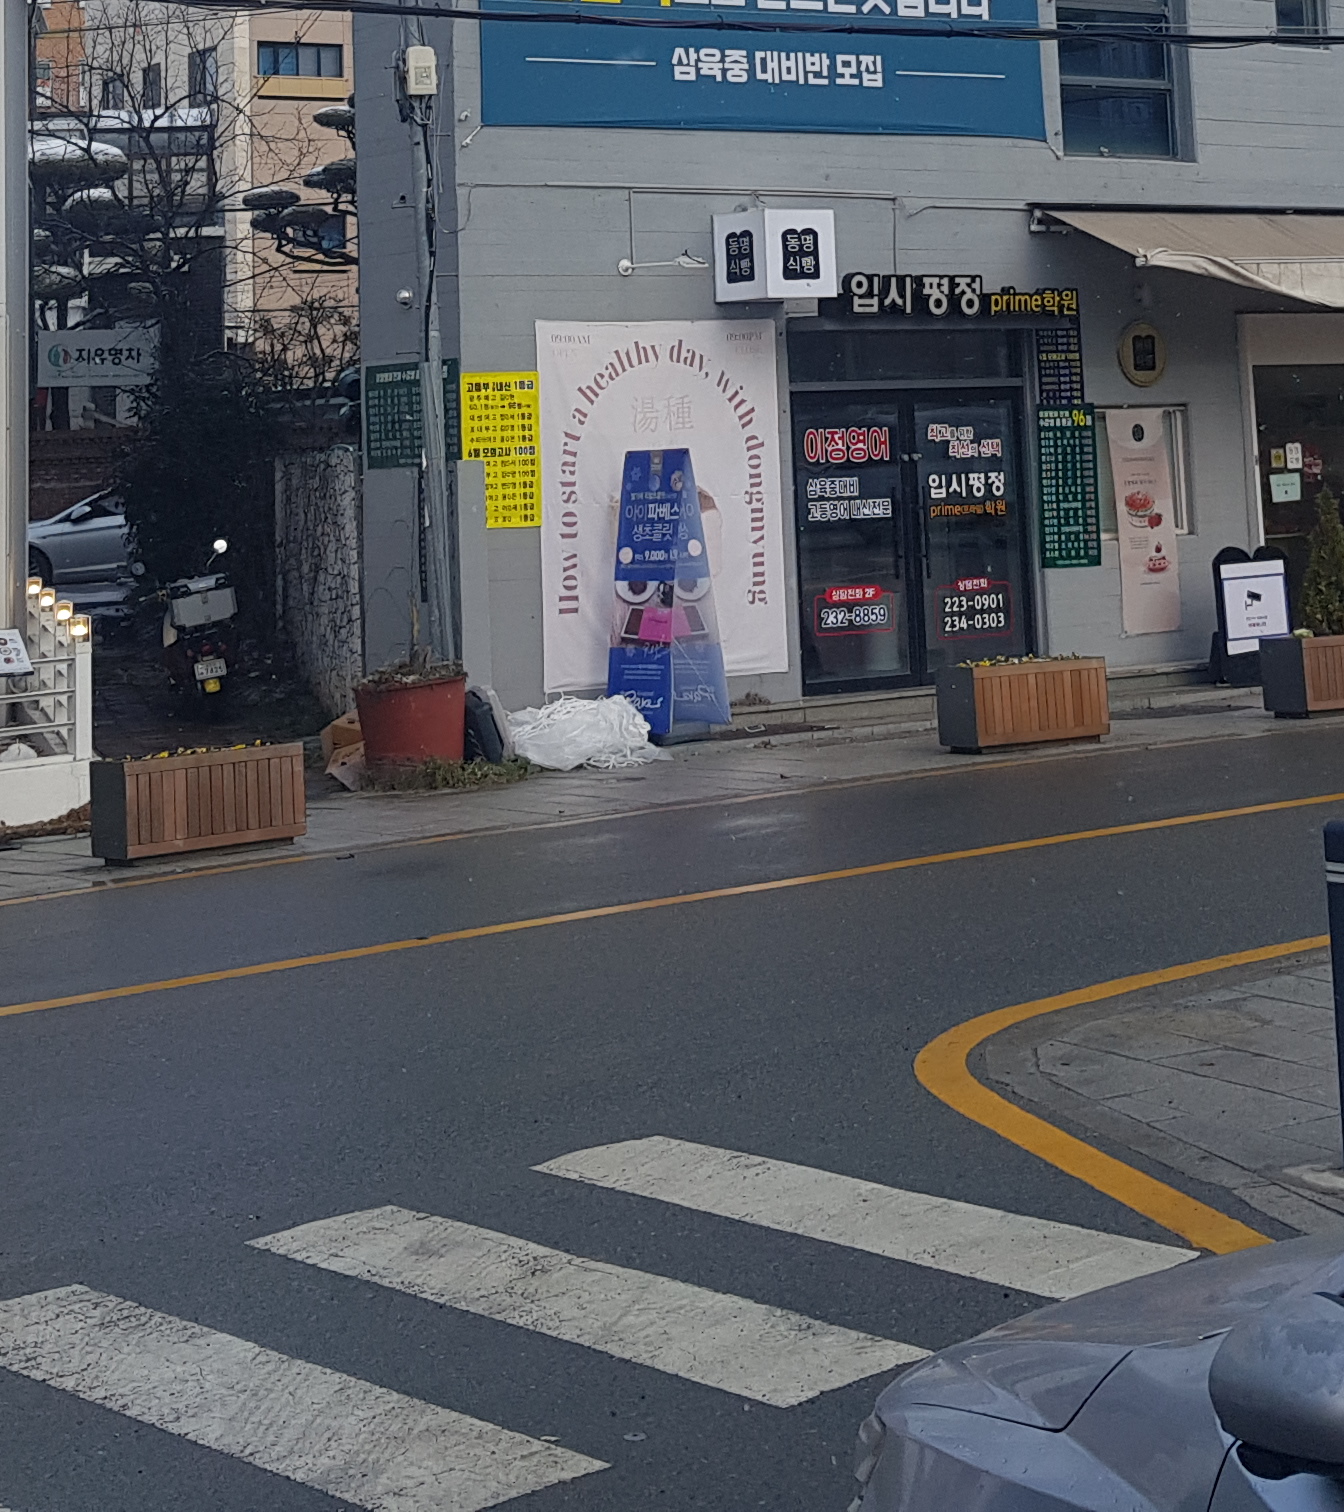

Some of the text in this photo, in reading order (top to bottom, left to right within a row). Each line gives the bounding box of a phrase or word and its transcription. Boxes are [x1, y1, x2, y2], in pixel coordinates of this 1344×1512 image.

[670, 46, 884, 89] 삼육중 대비반 모집
[728, 236, 751, 255] 동명
[785, 234, 814, 252] 동명
[991, 288, 1078, 316] prime학원
[577, 340, 660, 406] healthy
[716, 370, 756, 430] with
[571, 407, 588, 426] a
[804, 427, 890, 463] 이정영어
[559, 430, 582, 504] start
[928, 472, 1005, 499] 입시평정
[807, 498, 892, 521] 고등영어 내신전문
[560, 511, 579, 539] to
[558, 549, 580, 615] How
[944, 593, 1004, 612] 223-0901
[821, 605, 888, 628] 232-8859
[944, 613, 1005, 632] 234-0303
